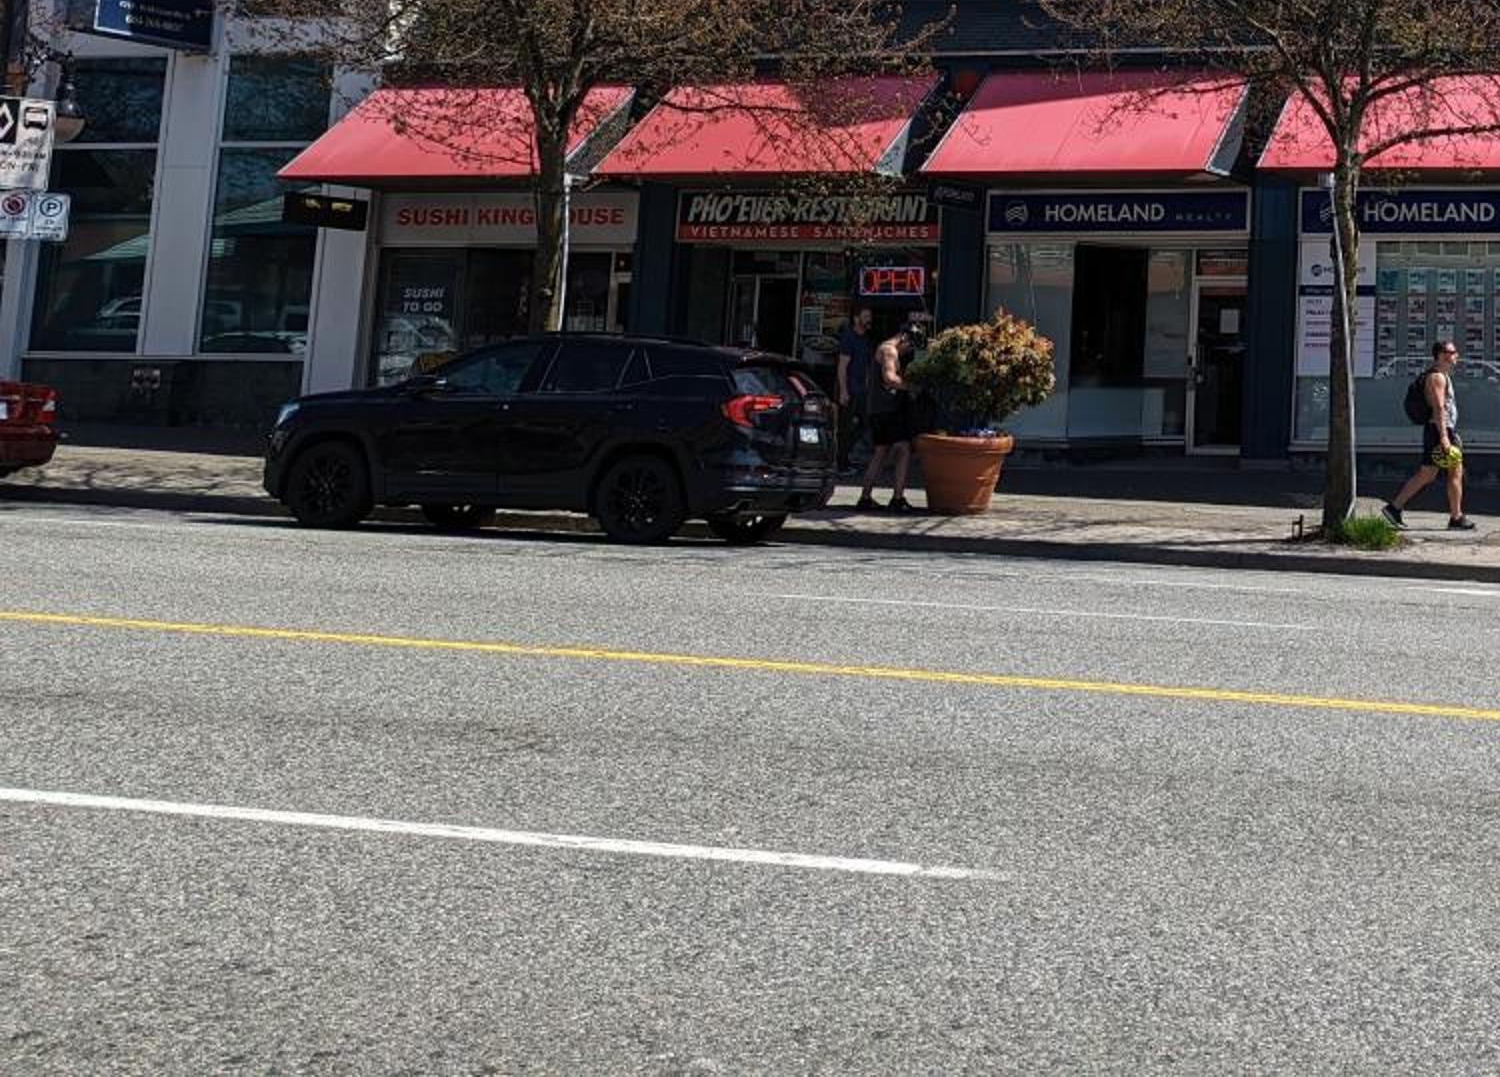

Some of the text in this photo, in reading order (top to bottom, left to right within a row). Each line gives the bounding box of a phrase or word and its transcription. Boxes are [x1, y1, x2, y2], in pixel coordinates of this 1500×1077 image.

[397, 208, 624, 225] SUSHI KING USE
[793, 195, 928, 223] RESTRANT
[1045, 203, 1165, 222] HOMELAND
[1363, 202, 1495, 222] HOMELAND
[690, 226, 799, 238] VIETNAMESE
[864, 269, 921, 293] OPEN
[403, 287, 445, 298] SUSHI
[403, 301, 444, 313] TO GO
